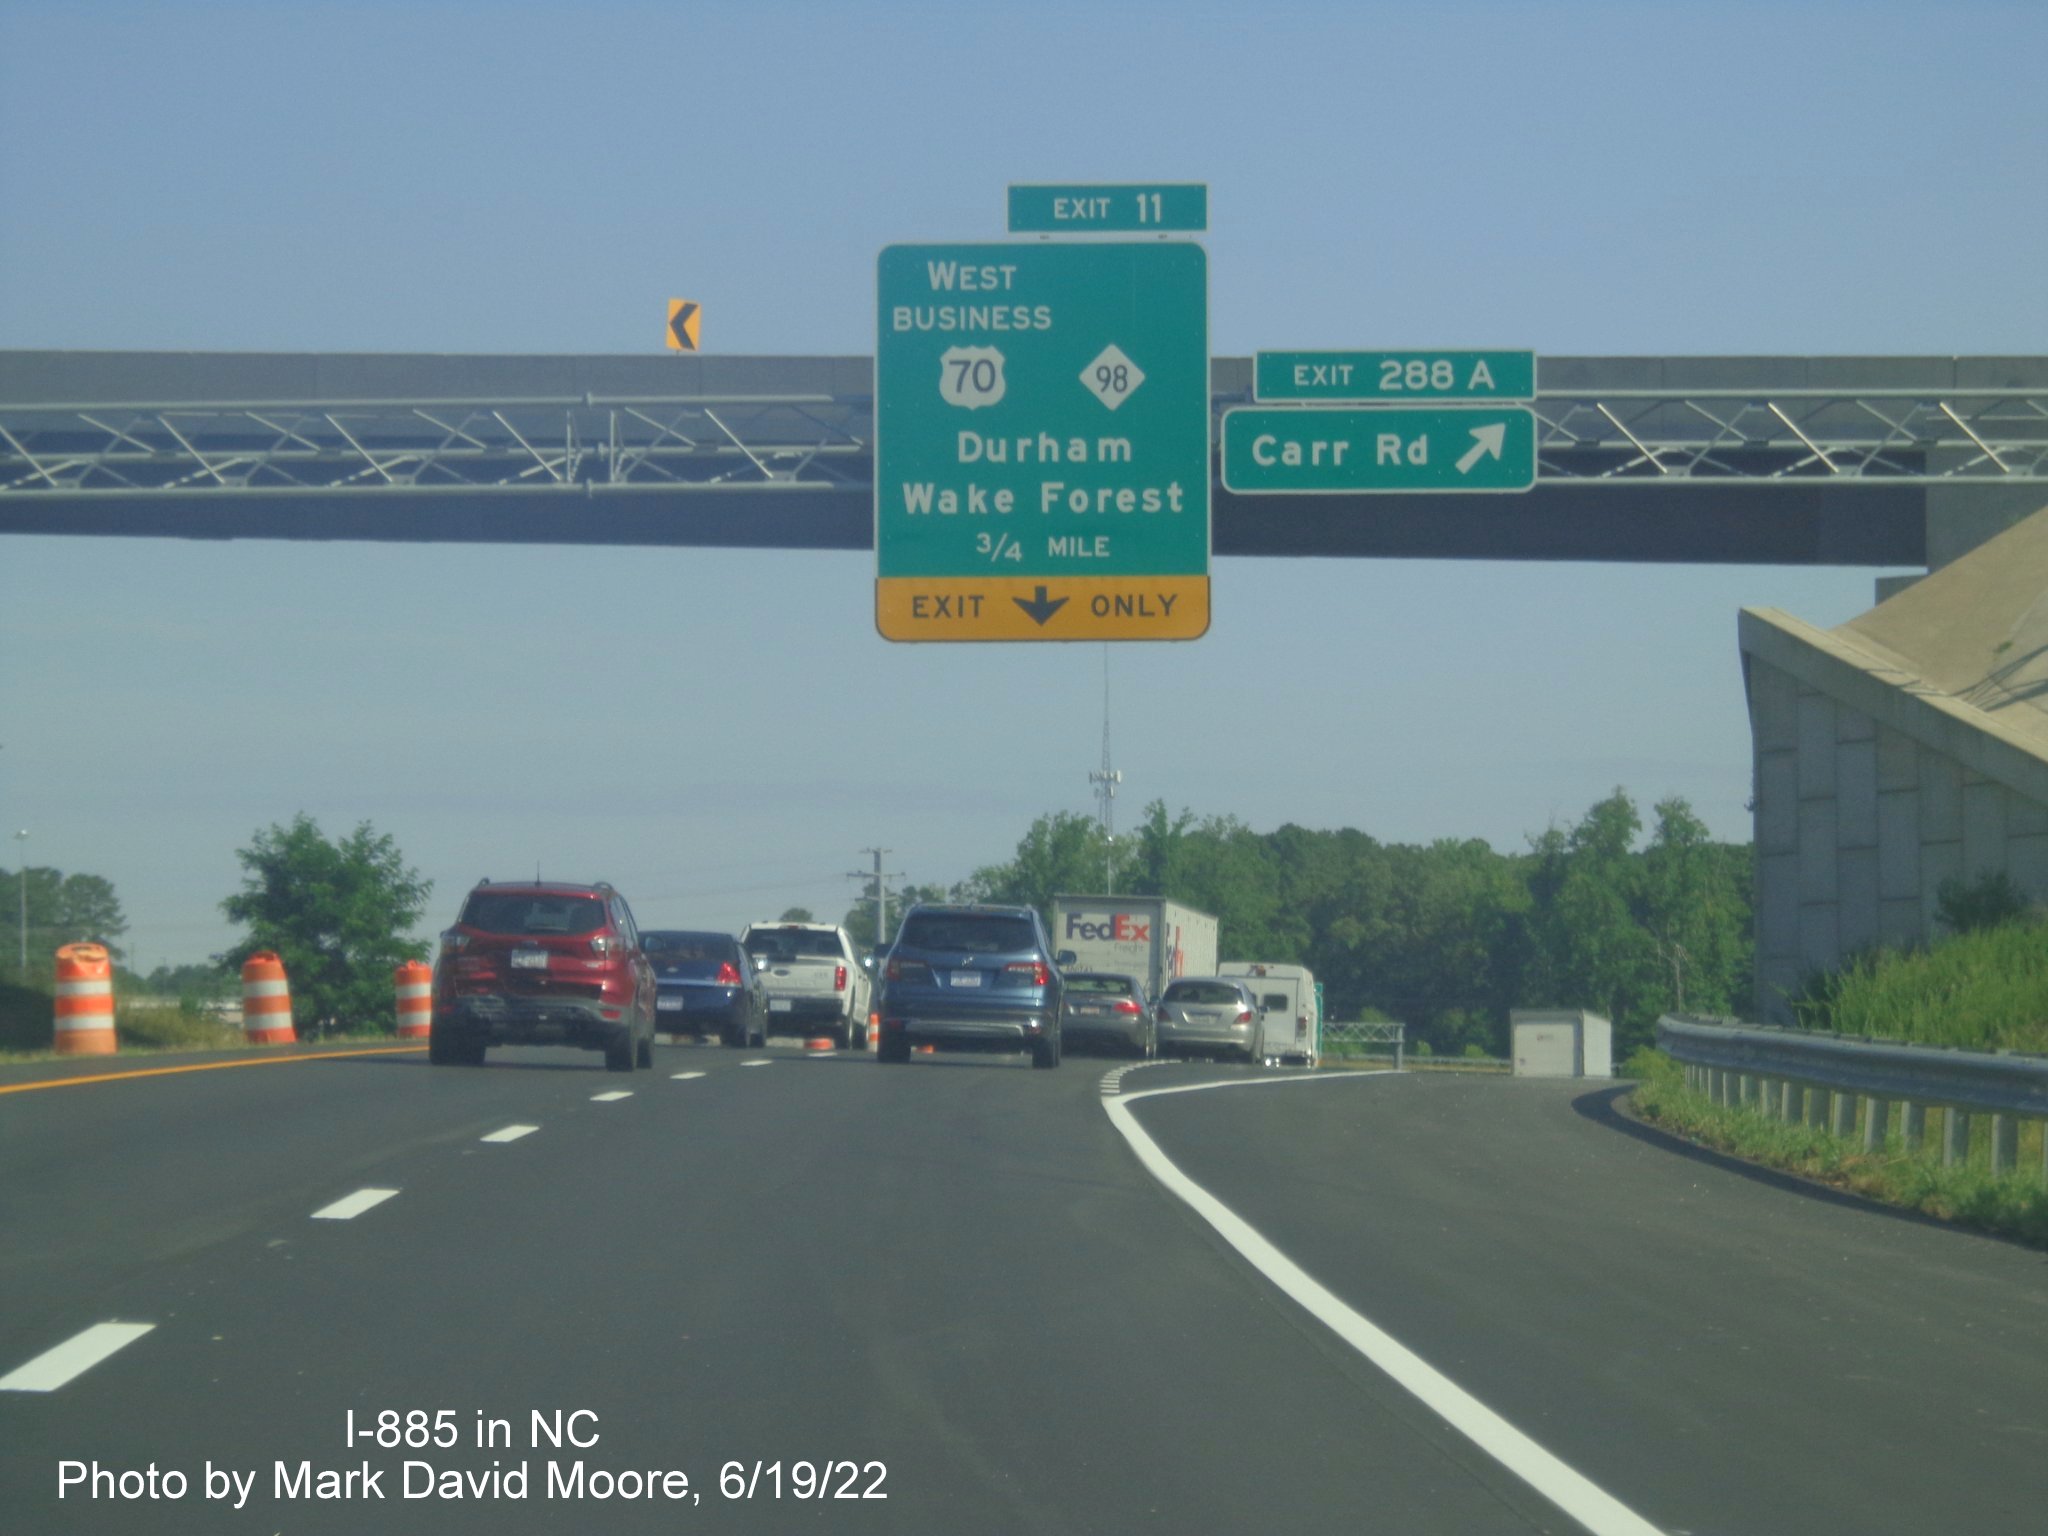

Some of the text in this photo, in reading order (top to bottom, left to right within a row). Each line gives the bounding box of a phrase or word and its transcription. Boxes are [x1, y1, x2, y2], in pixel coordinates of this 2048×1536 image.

[1053, 192, 1162, 223] EXIT 11
[927, 260, 1017, 291] WEST
[892, 305, 1052, 332] BUSINESS
[948, 358, 997, 394] 70
[1095, 364, 1128, 394] 98
[1293, 359, 1496, 391] EXIT 288 A
[957, 430, 1132, 463] Durham
[1252, 433, 1429, 467] Carr Rd
[902, 481, 1183, 515] Wake Forest
[976, 531, 1110, 562] 3/4 MILE
[911, 593, 1178, 619] EXIT ONLY
[1065, 912, 1150, 942] FedEx
